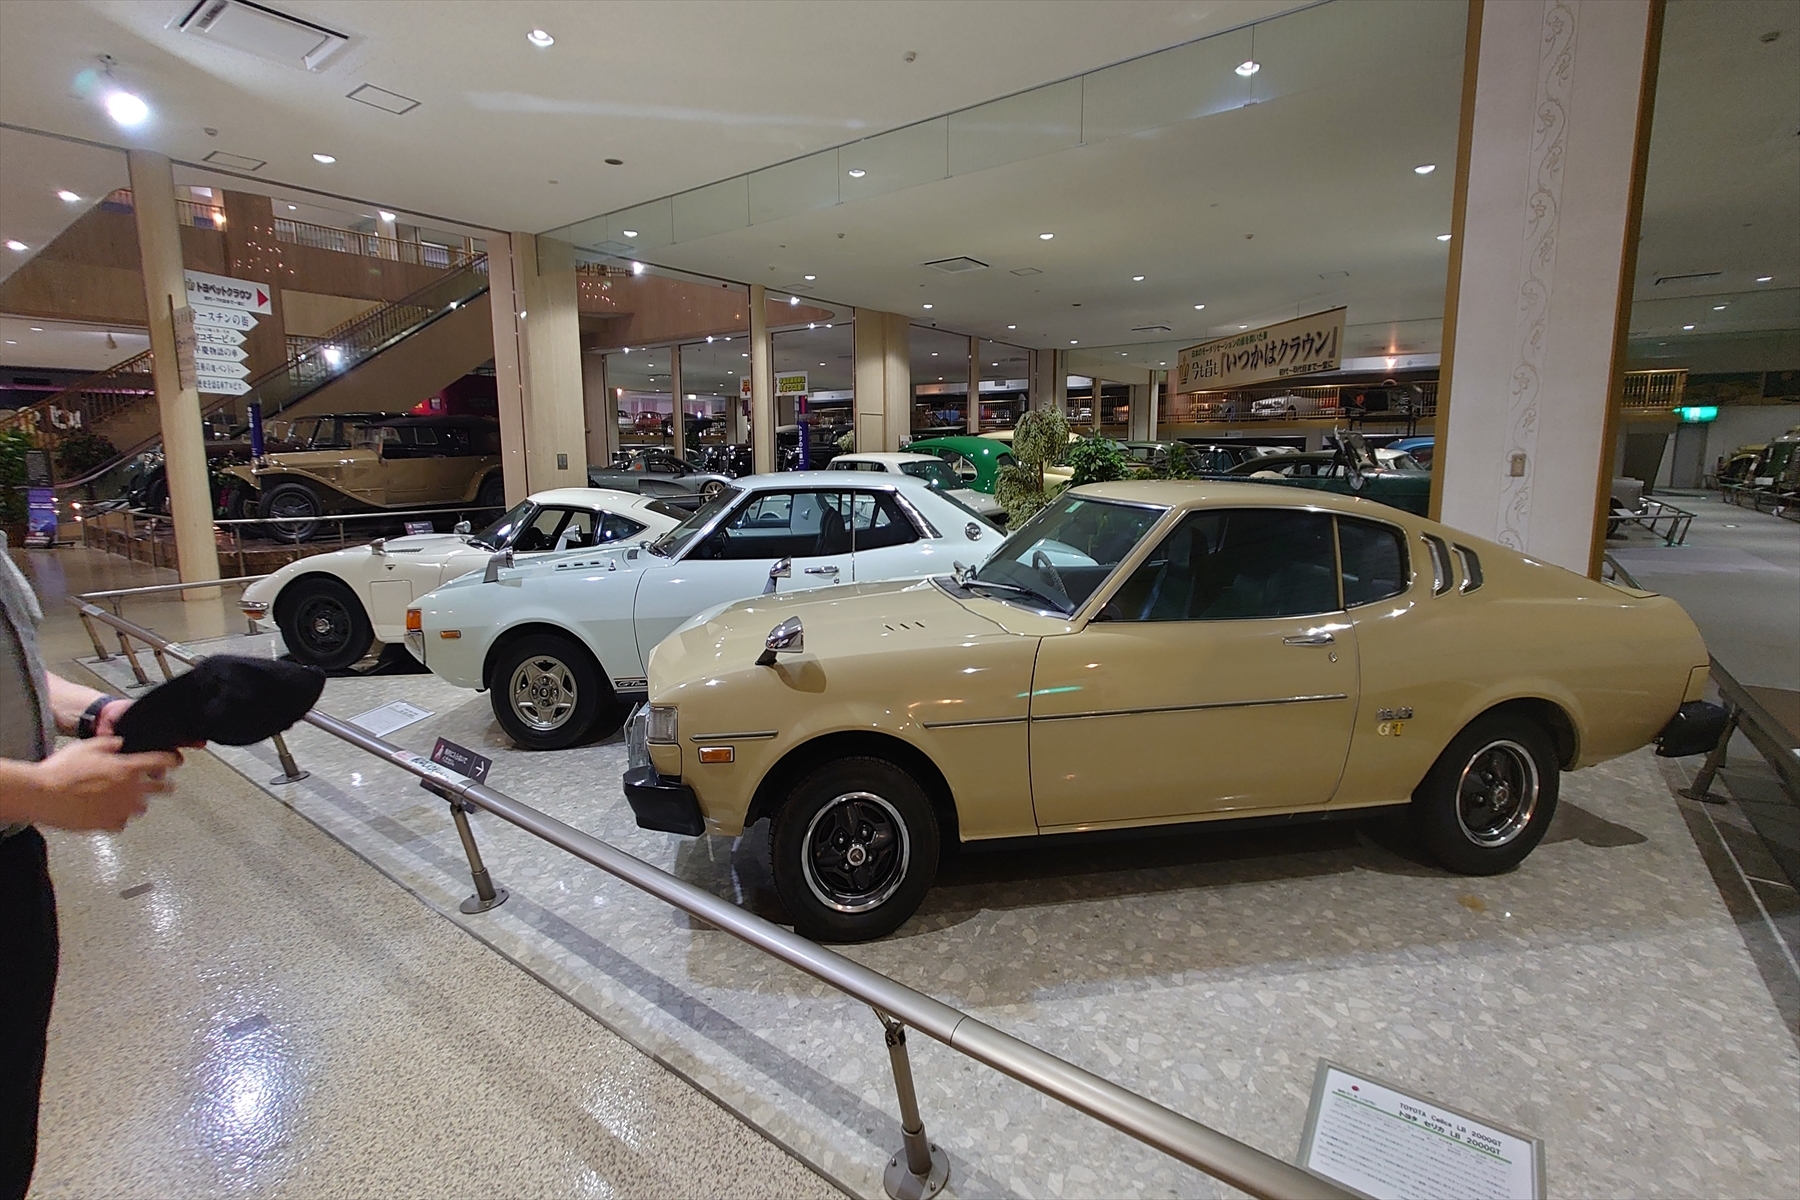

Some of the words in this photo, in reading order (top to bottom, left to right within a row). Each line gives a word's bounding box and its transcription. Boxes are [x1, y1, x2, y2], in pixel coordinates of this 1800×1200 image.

[196, 281, 252, 300] トヨペットクラウン
[1377, 721, 1405, 737] GT
[1399, 1102, 1427, 1118] TOYOTA
[1431, 1114, 1453, 1128] Celica
[1456, 1124, 1467, 1134] LB
[1471, 1130, 1502, 1147] 2000GT
[1399, 1110, 1418, 1123] トヨタ
[1424, 1120, 1446, 1133] セリカ
[1450, 1130, 1461, 1141] LB
[1466, 1138, 1501, 1156] 2000GT
